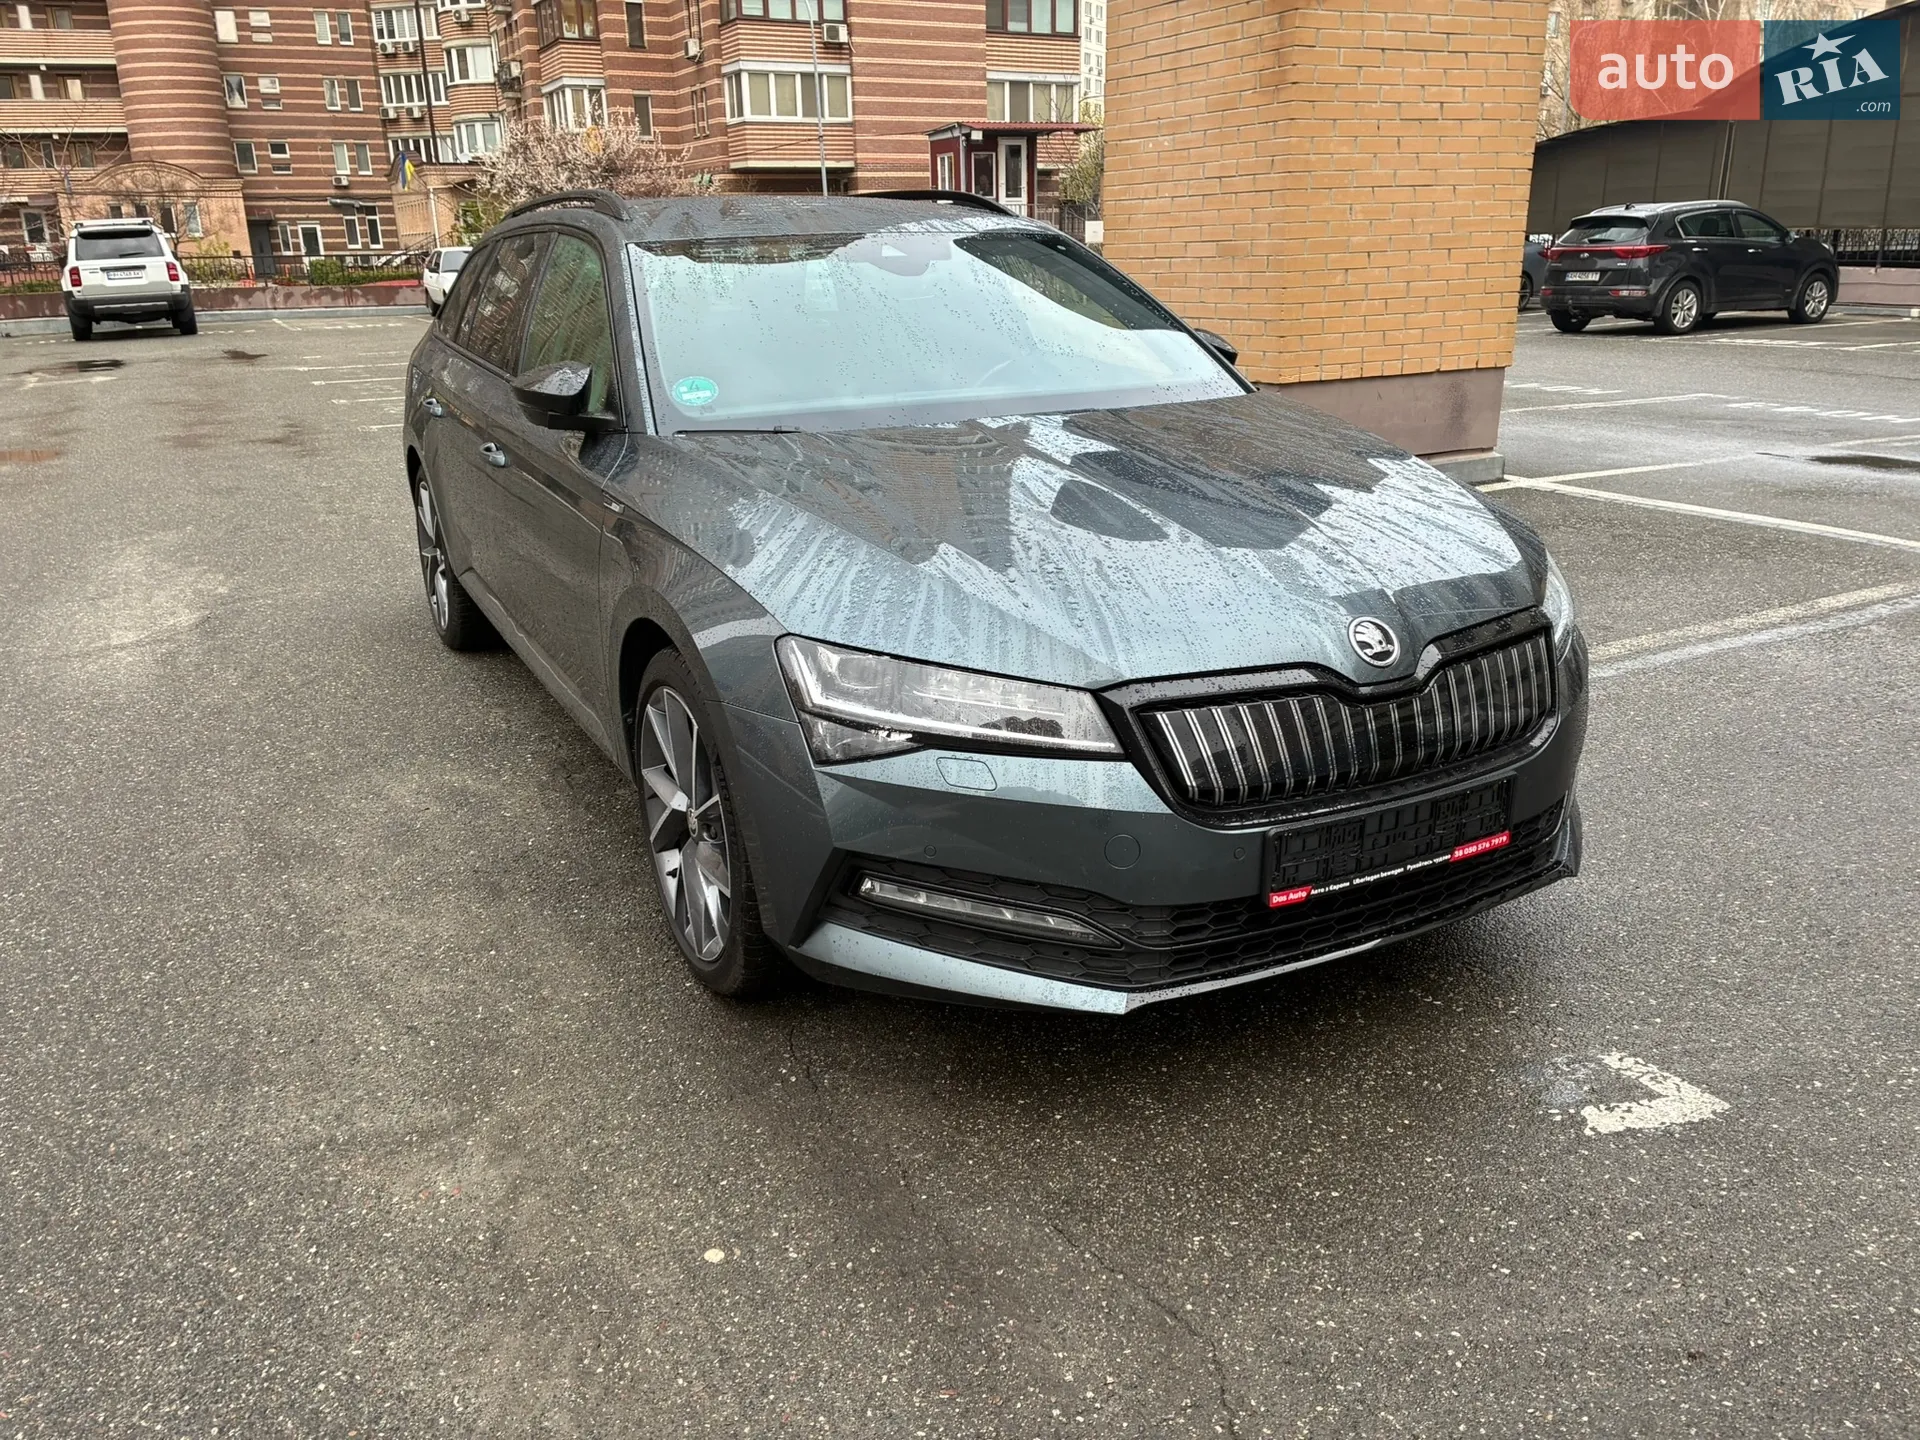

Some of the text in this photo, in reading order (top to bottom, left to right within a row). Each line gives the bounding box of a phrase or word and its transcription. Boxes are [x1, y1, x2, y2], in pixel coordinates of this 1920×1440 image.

[1463, 845, 1477, 855] 050
[1490, 835, 1507, 847] 7979
[1272, 890, 1307, 903] Das Auto
